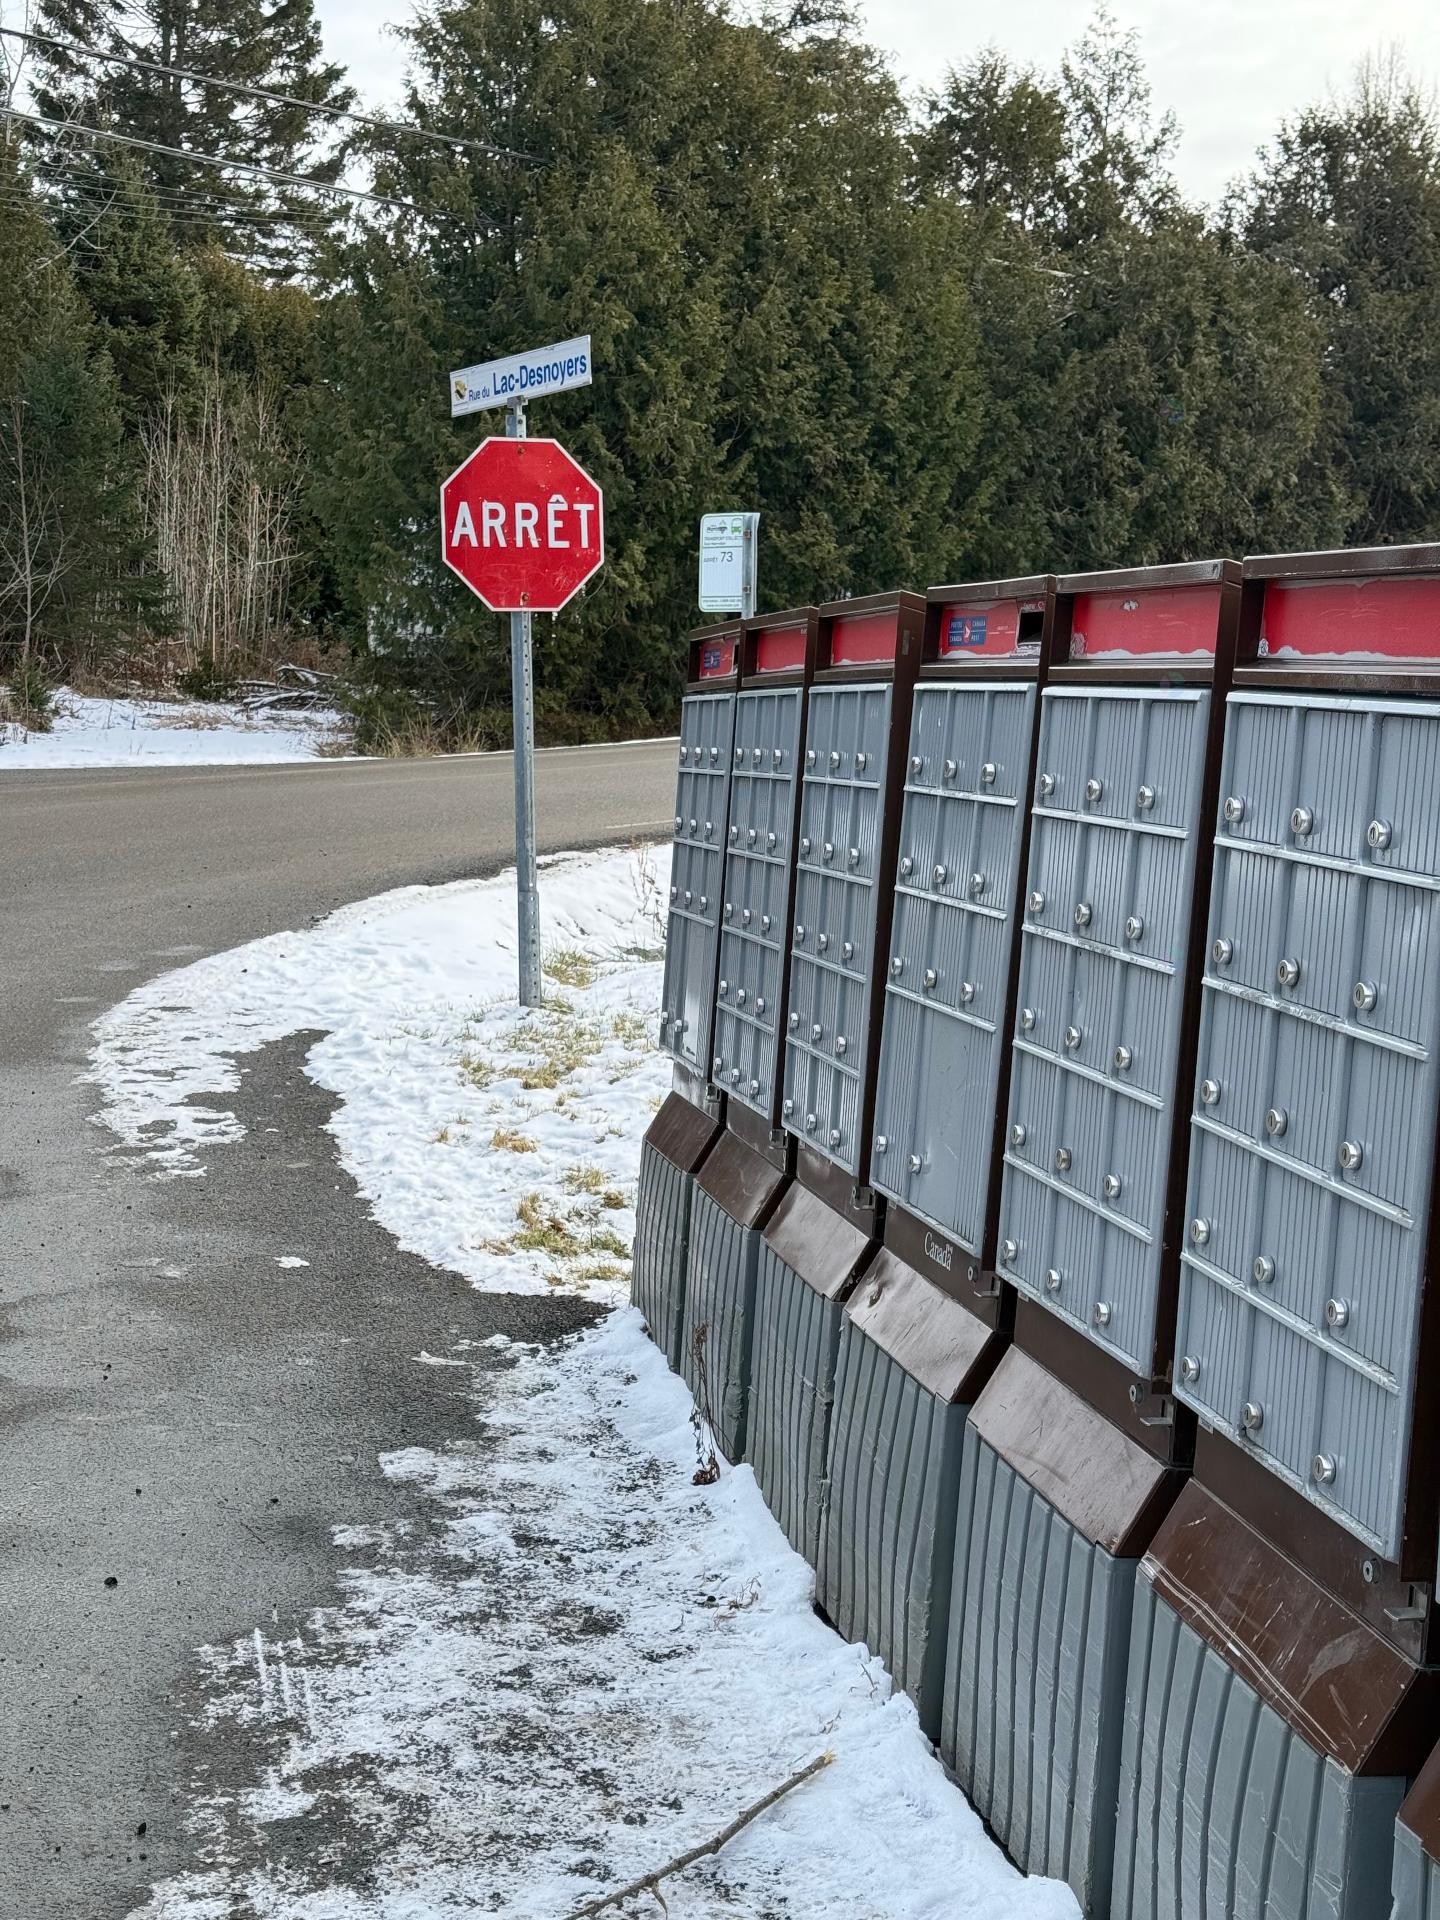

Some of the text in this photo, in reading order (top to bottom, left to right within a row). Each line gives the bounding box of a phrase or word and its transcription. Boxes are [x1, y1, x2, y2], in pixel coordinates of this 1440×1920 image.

[468, 354, 587, 402] Rue du Lac-Desnoyers
[451, 494, 595, 549] ARRÊT
[720, 551, 733, 562] 73
[924, 1231, 953, 1271] Canada
